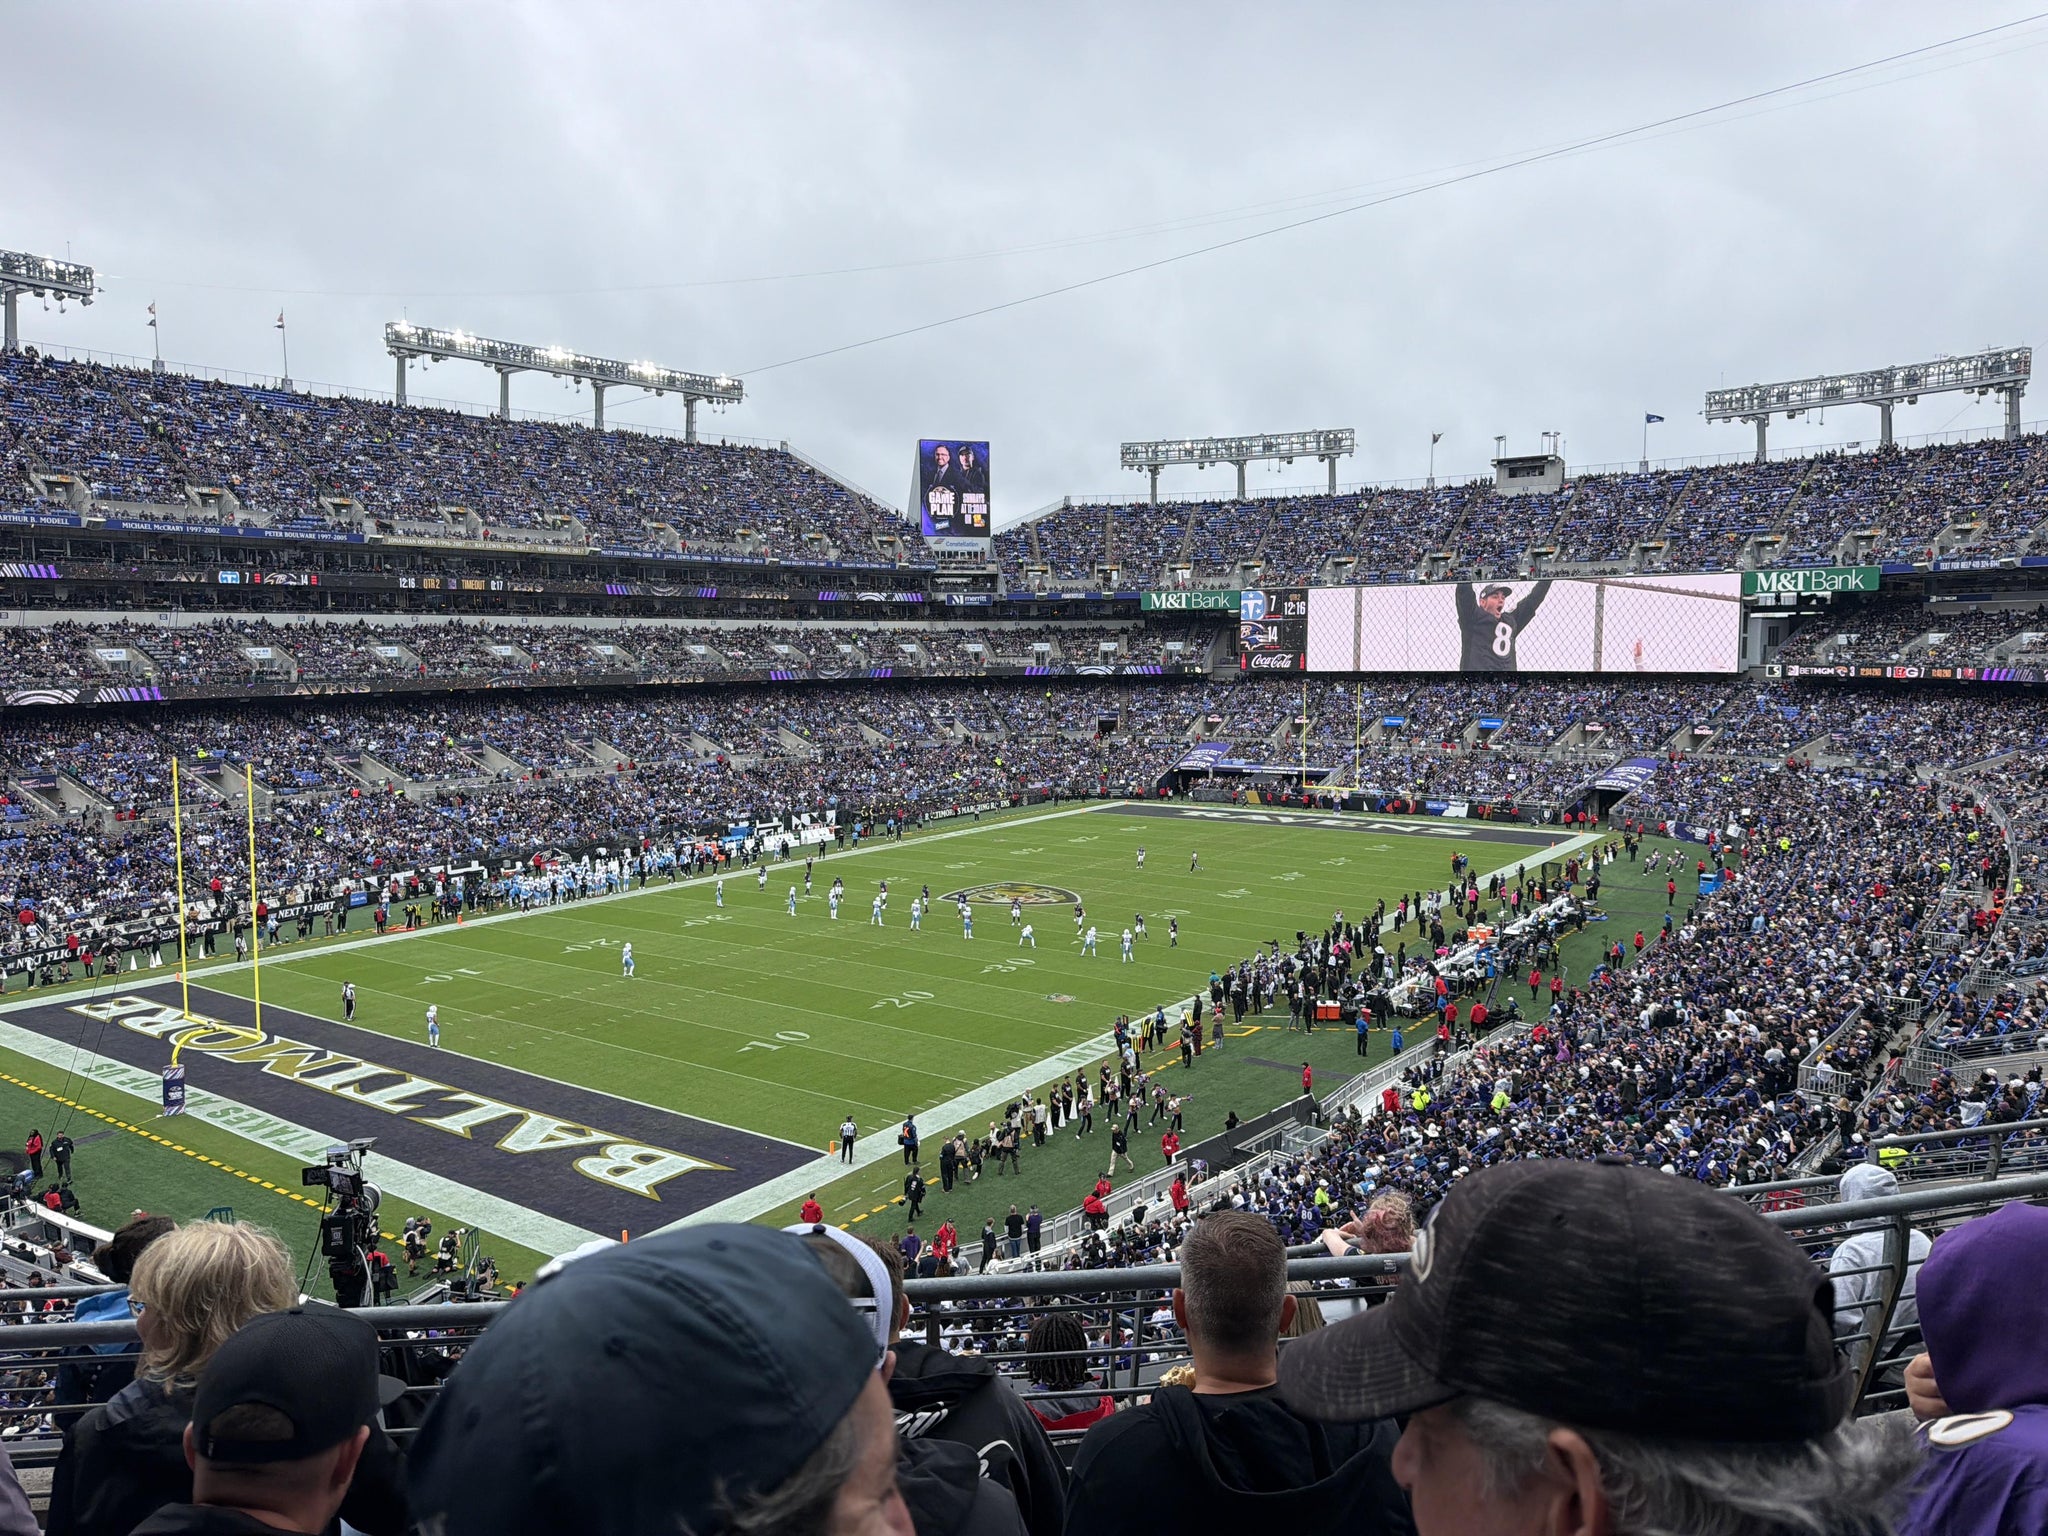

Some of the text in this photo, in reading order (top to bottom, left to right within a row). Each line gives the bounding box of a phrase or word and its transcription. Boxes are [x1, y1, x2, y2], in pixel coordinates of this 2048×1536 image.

[928, 491, 955, 504] GAME
[930, 503, 954, 516] PLAN
[40, 516, 70, 526] MODELL
[122, 521, 152, 531] MICHAEL
[186, 525, 220, 535] 1997-2002
[264, 530, 348, 542] PETER BOULWARE 1997-2005
[388, 537, 416, 546] JONATHAN
[416, 538, 437, 547] OGDEN
[244, 572, 250, 584] 7
[301, 575, 309, 586] 14
[399, 578, 416, 589] 12:16
[461, 579, 485, 591] TIMEOUT
[1755, 570, 1865, 592] M&T Bank
[490, 580, 503, 591] 0:17
[964, 594, 987, 602] merritt
[1150, 592, 1230, 609] M&T Bank
[1270, 595, 1277, 612] 7
[1283, 601, 1306, 615] 12:16
[1268, 626, 1278, 643] 14
[1492, 621, 1513, 657] 8
[1251, 653, 1294, 669] Coca-Cola
[1799, 667, 1835, 675] BETMGM
[1182, 809, 1474, 837] RAVENS
[277, 905, 302, 919] NEXT
[563, 937, 621, 953] 20
[987, 957, 1036, 974] 30
[424, 967, 484, 984] 10
[876, 989, 936, 1009] 20
[744, 1029, 811, 1052] 10
[82, 1062, 124, 1080] US
[116, 1074, 163, 1092] OF
[60, 995, 736, 1203] BALTIMORE
[206, 1105, 317, 1148] TAKES
[1707, 1159, 1717, 1170] 8
[1301, 1210, 1313, 1221] 80
